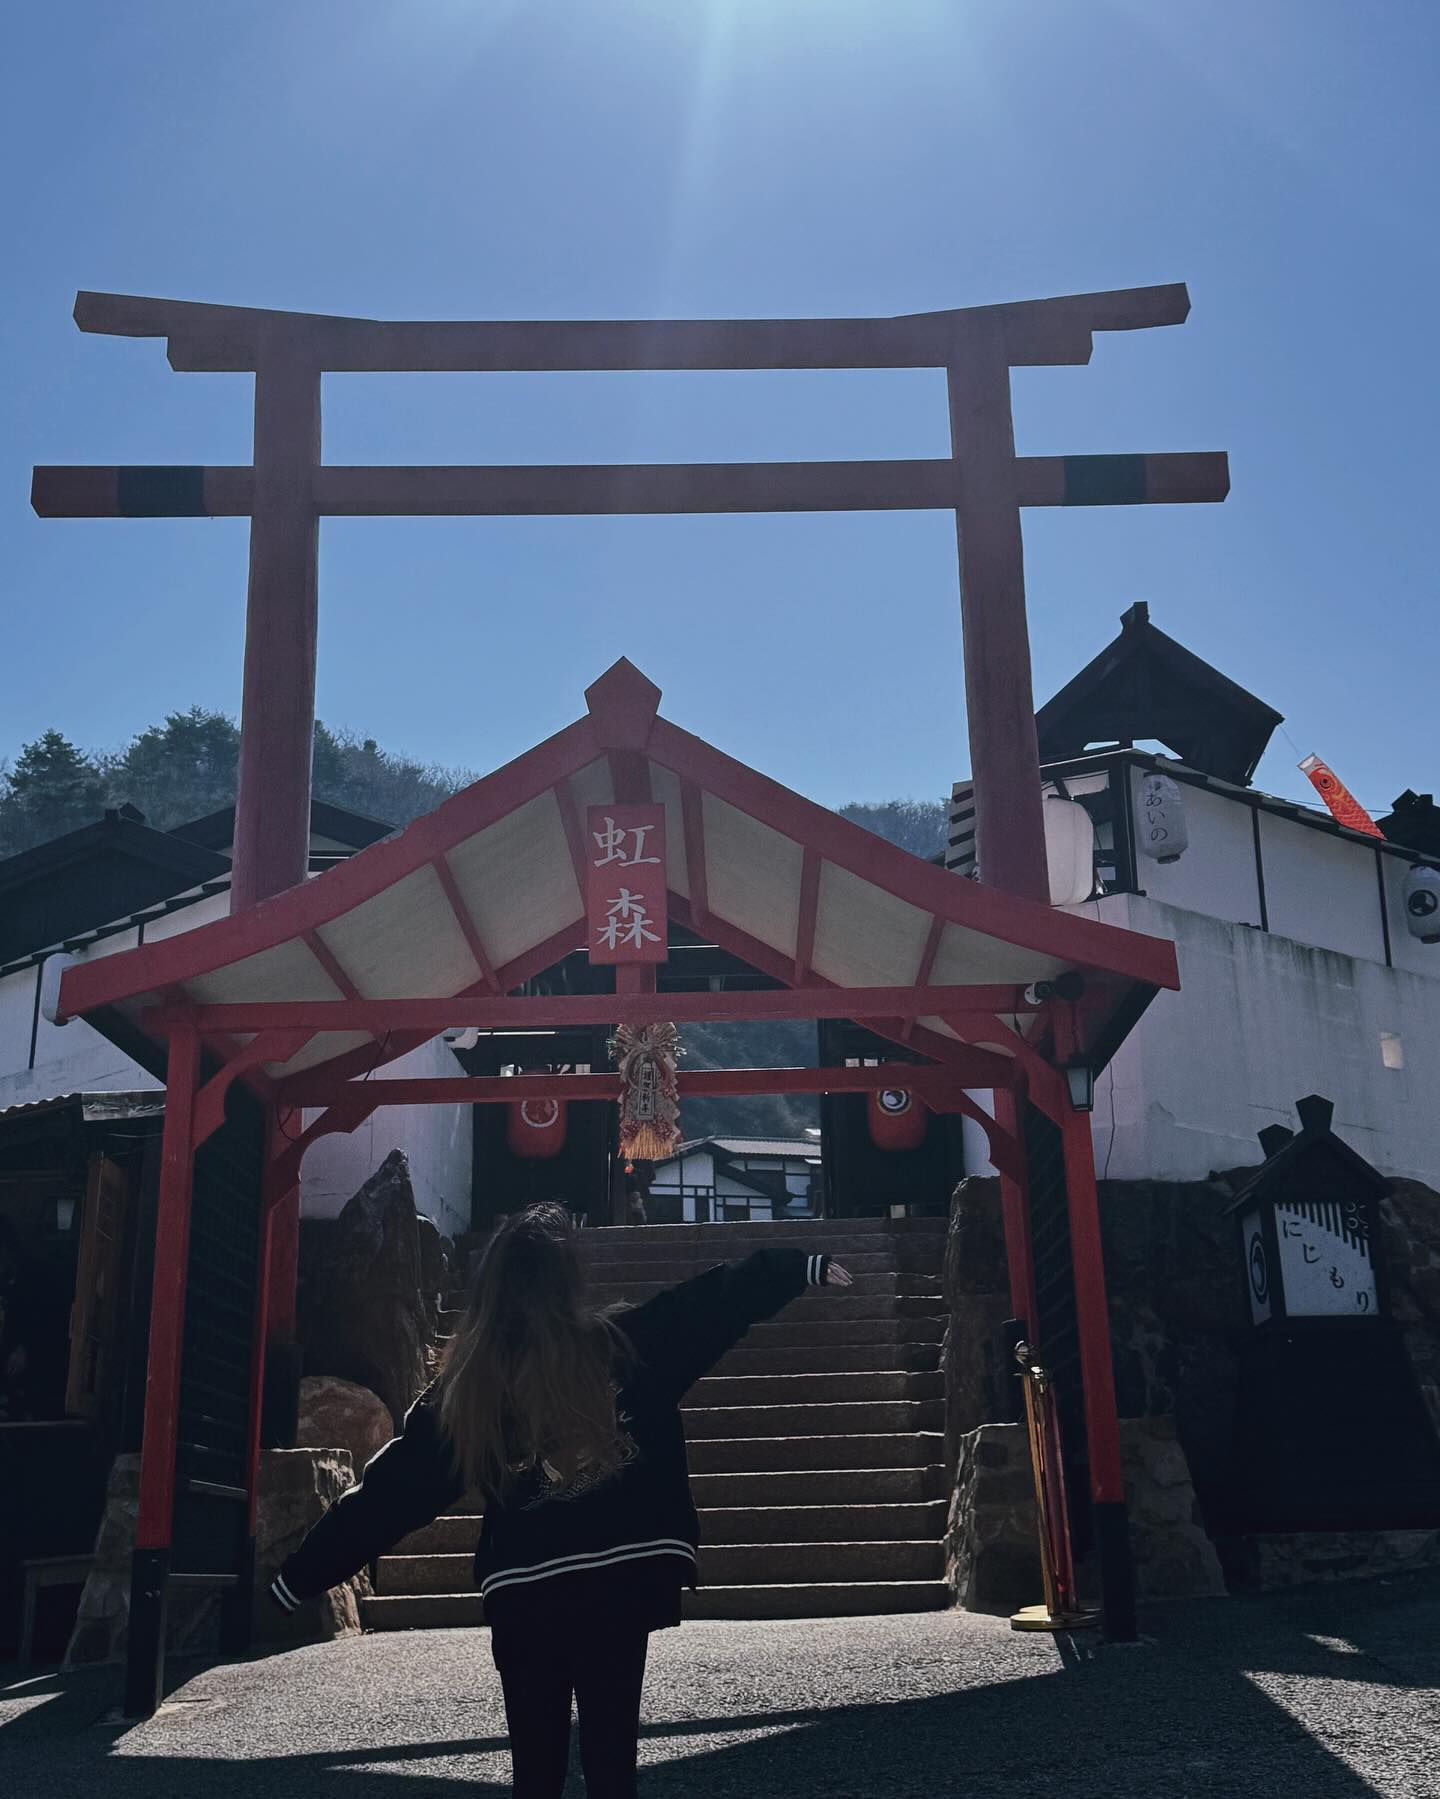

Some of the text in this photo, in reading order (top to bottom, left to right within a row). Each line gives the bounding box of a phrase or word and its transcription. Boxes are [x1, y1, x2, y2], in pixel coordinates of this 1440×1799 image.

[593, 816, 661, 950] 虹森
[1283, 1220, 1369, 1313] にじもり
